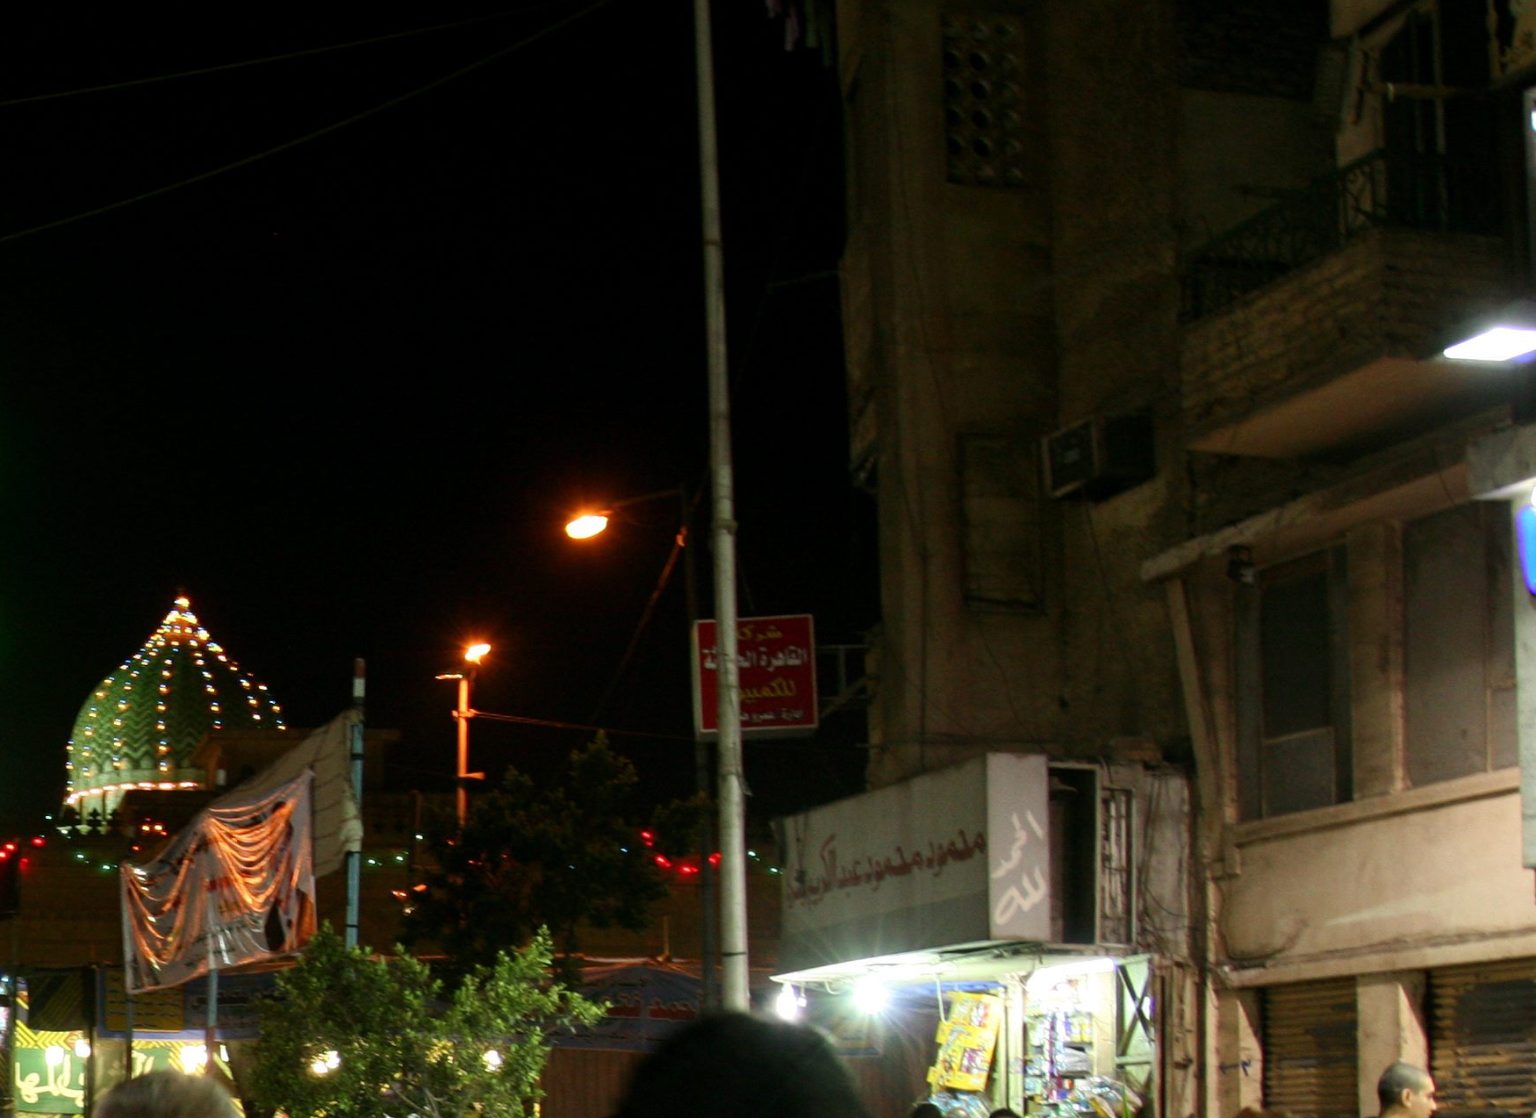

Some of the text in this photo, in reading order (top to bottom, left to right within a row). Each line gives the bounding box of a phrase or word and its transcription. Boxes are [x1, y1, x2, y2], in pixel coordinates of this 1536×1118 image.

[737, 625, 784, 641] شرك
[758, 645, 809, 672] القاهرة
[990, 809, 1045, 880] الحمد
[994, 865, 1049, 926] لله
